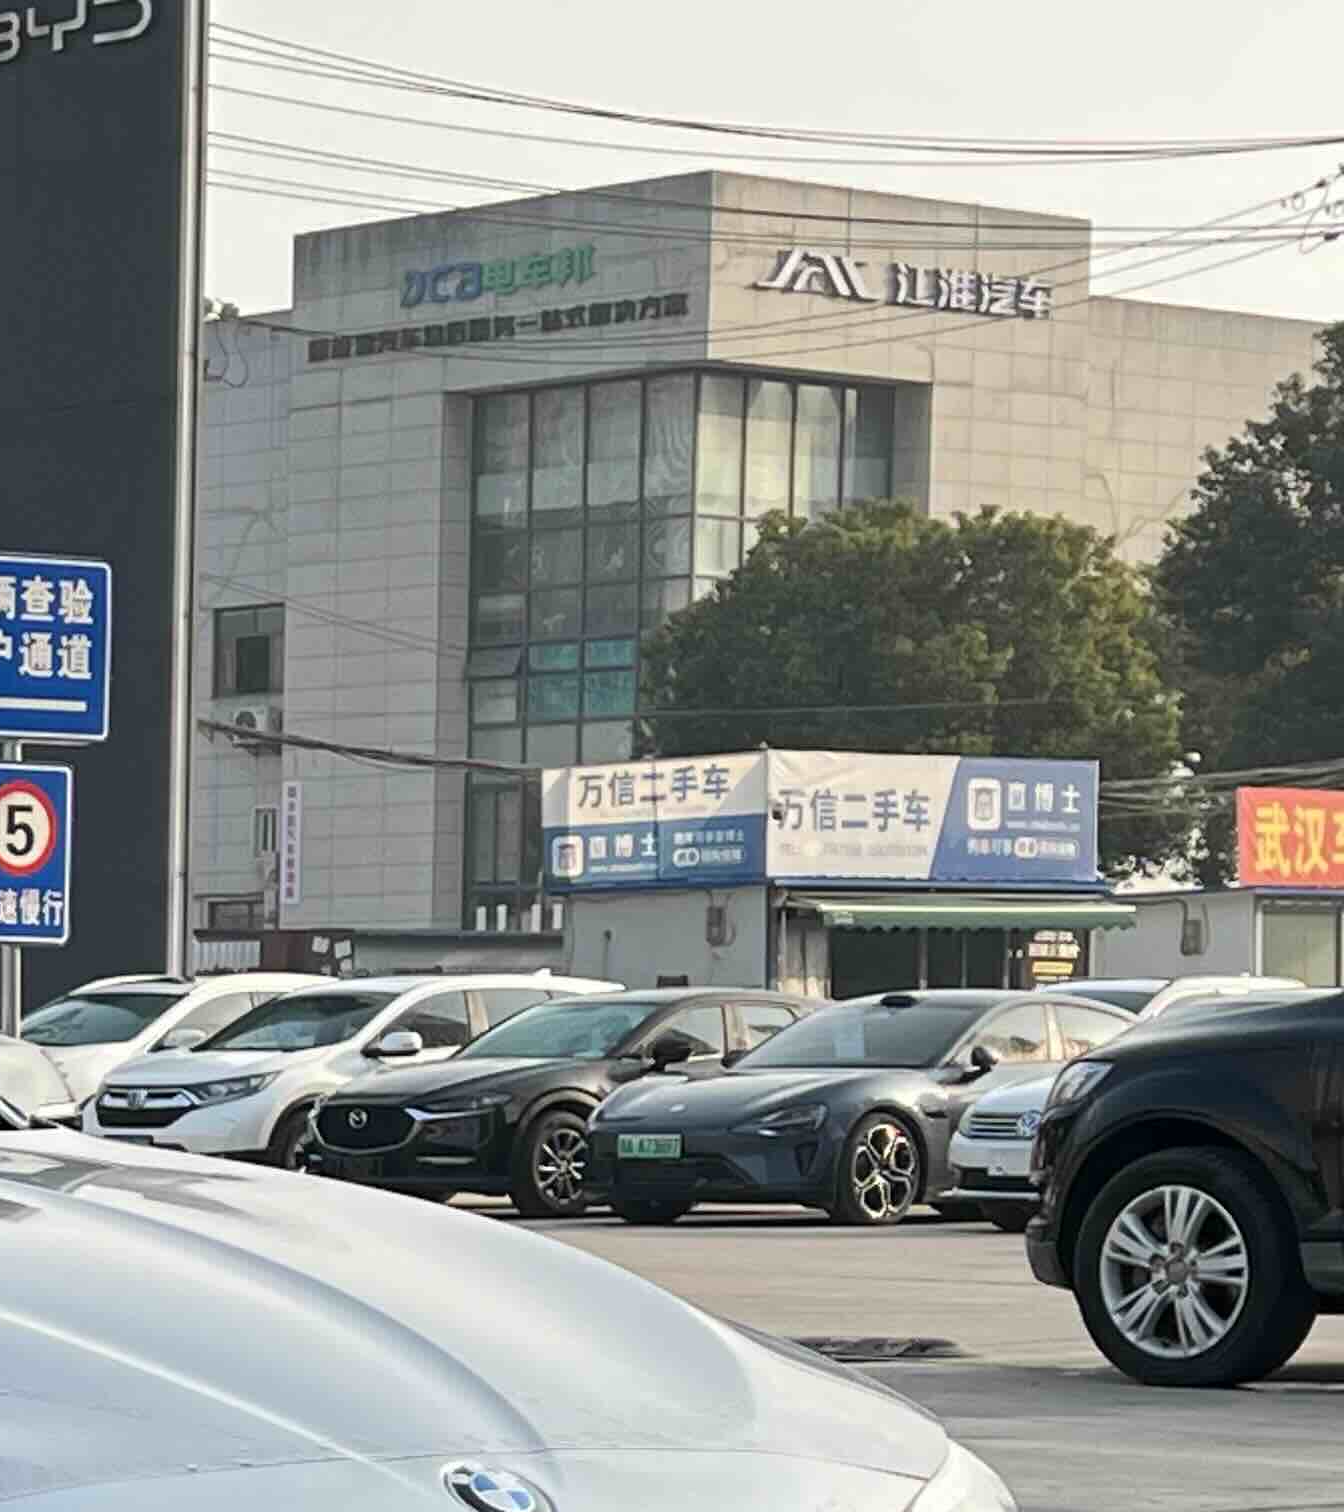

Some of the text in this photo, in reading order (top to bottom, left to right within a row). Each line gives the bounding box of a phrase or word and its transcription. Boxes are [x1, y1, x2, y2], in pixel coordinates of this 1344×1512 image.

[890, 260, 1054, 318] 江淮汽车
[577, 763, 732, 808] 万信二手车
[776, 787, 932, 833] 万信二手车
[5, 804, 35, 857] 5
